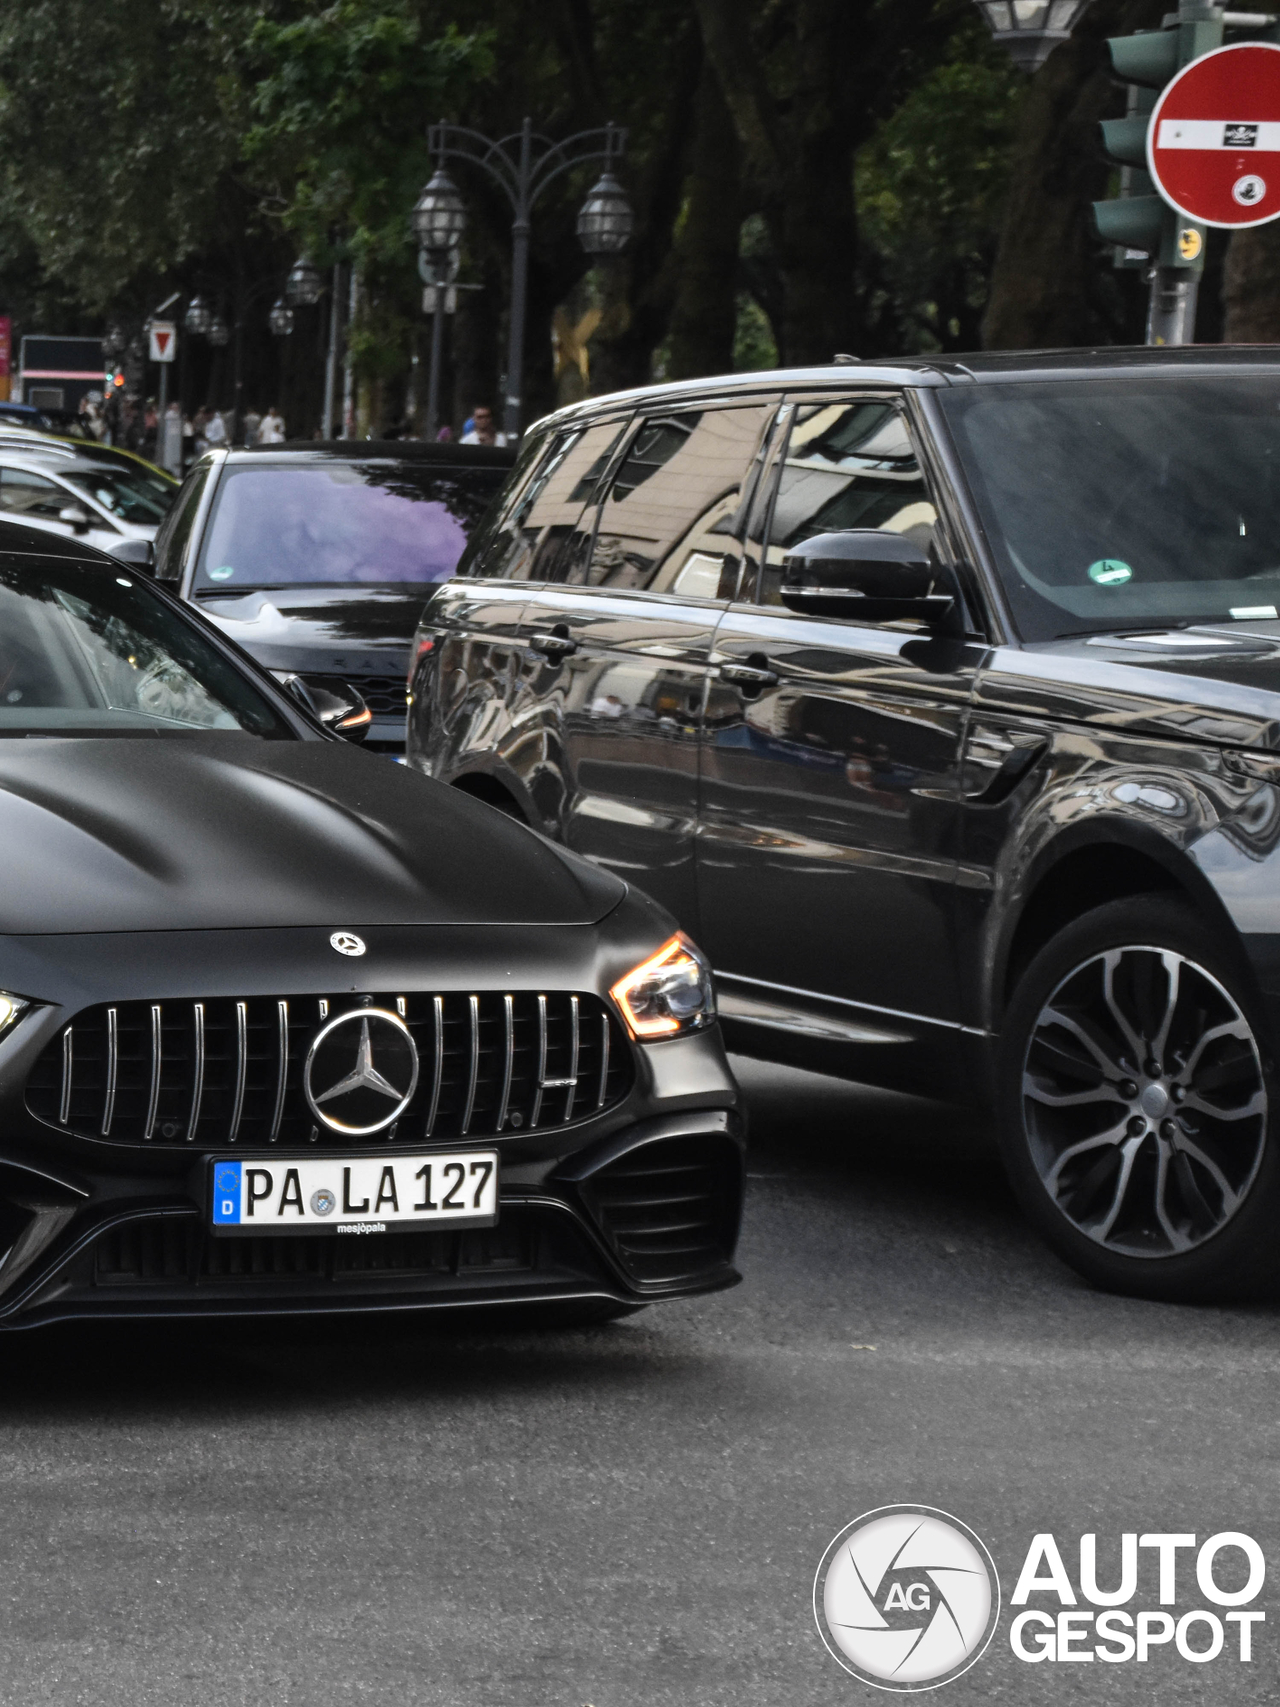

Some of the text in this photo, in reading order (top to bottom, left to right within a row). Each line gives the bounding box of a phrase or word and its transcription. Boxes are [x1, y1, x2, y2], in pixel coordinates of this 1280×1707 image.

[245, 1161, 493, 1217] PA LA 127
[222, 1200, 233, 1216] D
